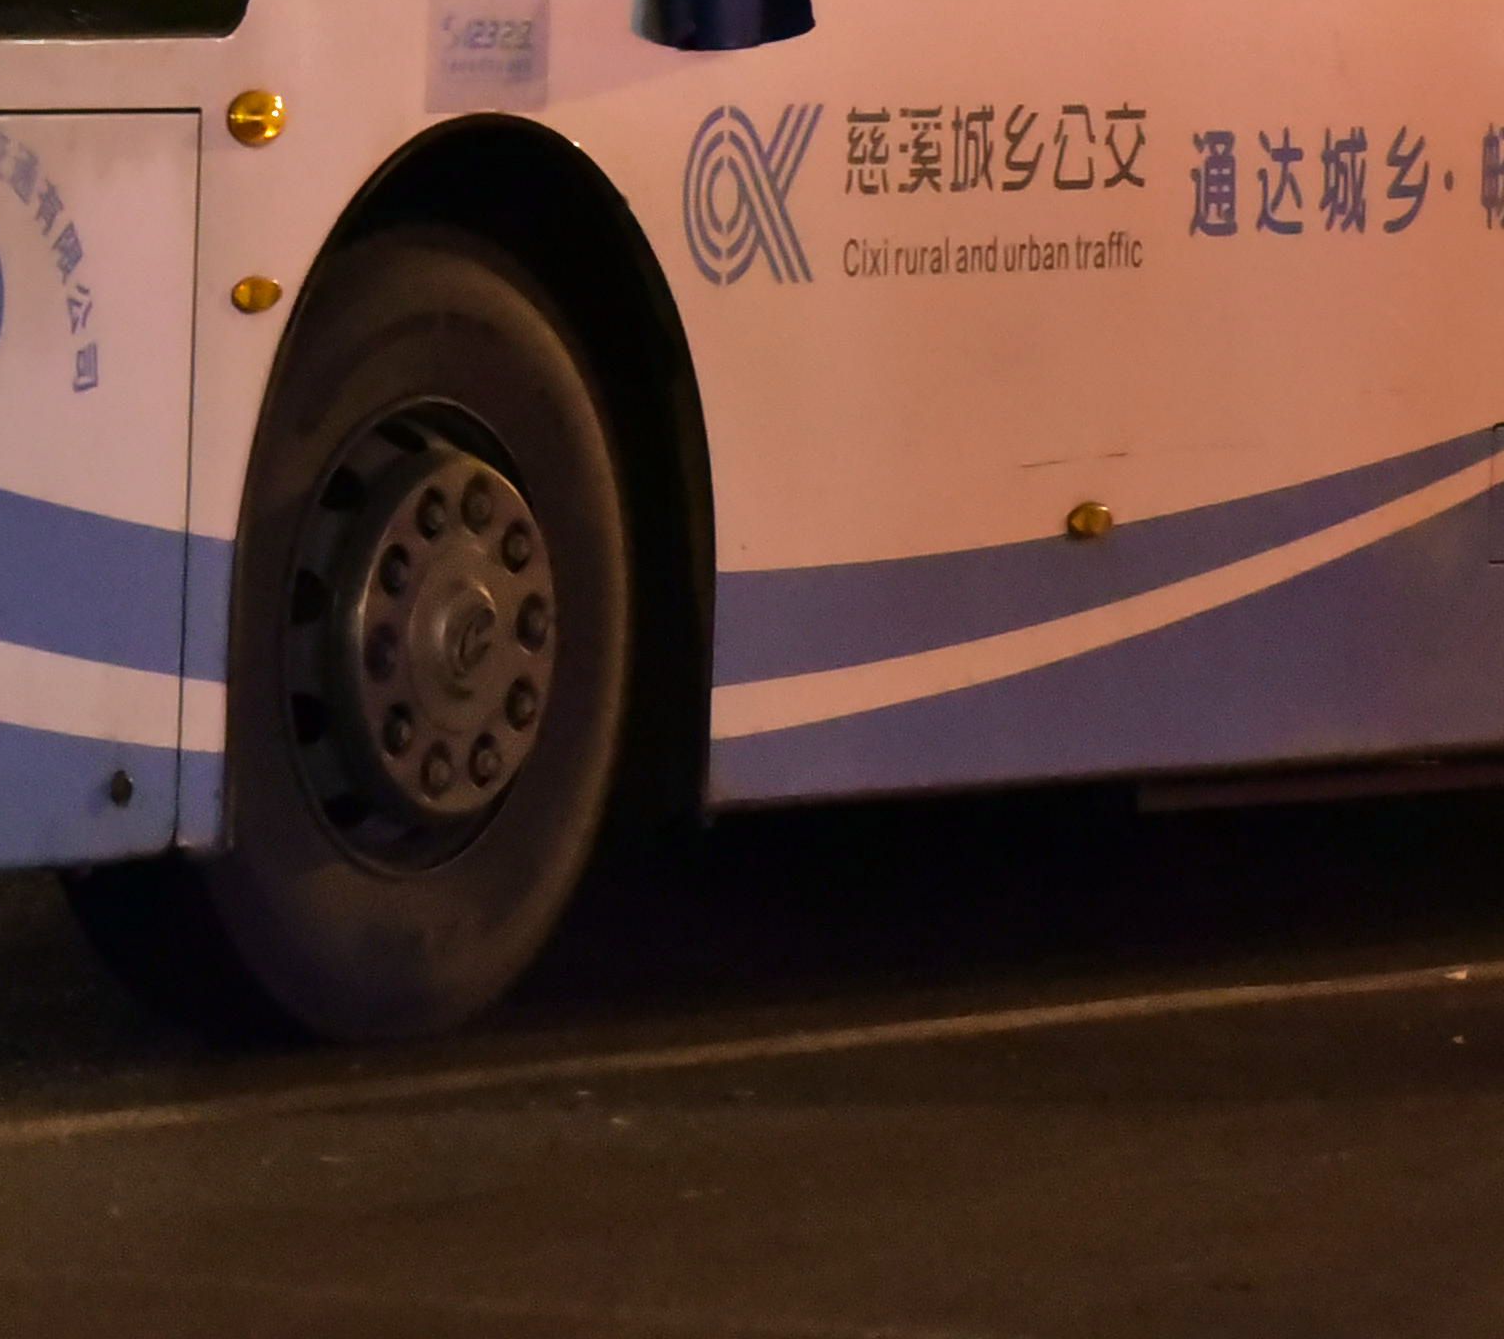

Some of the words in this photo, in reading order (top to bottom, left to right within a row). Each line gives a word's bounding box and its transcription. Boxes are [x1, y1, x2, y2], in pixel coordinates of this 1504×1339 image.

[844, 102, 1147, 195] 慈溪城乡公交
[842, 237, 889, 278] Cixi
[893, 236, 951, 277] rural
[954, 234, 996, 275] and
[1002, 235, 1070, 272] urban
[1074, 231, 1145, 271] traffic
